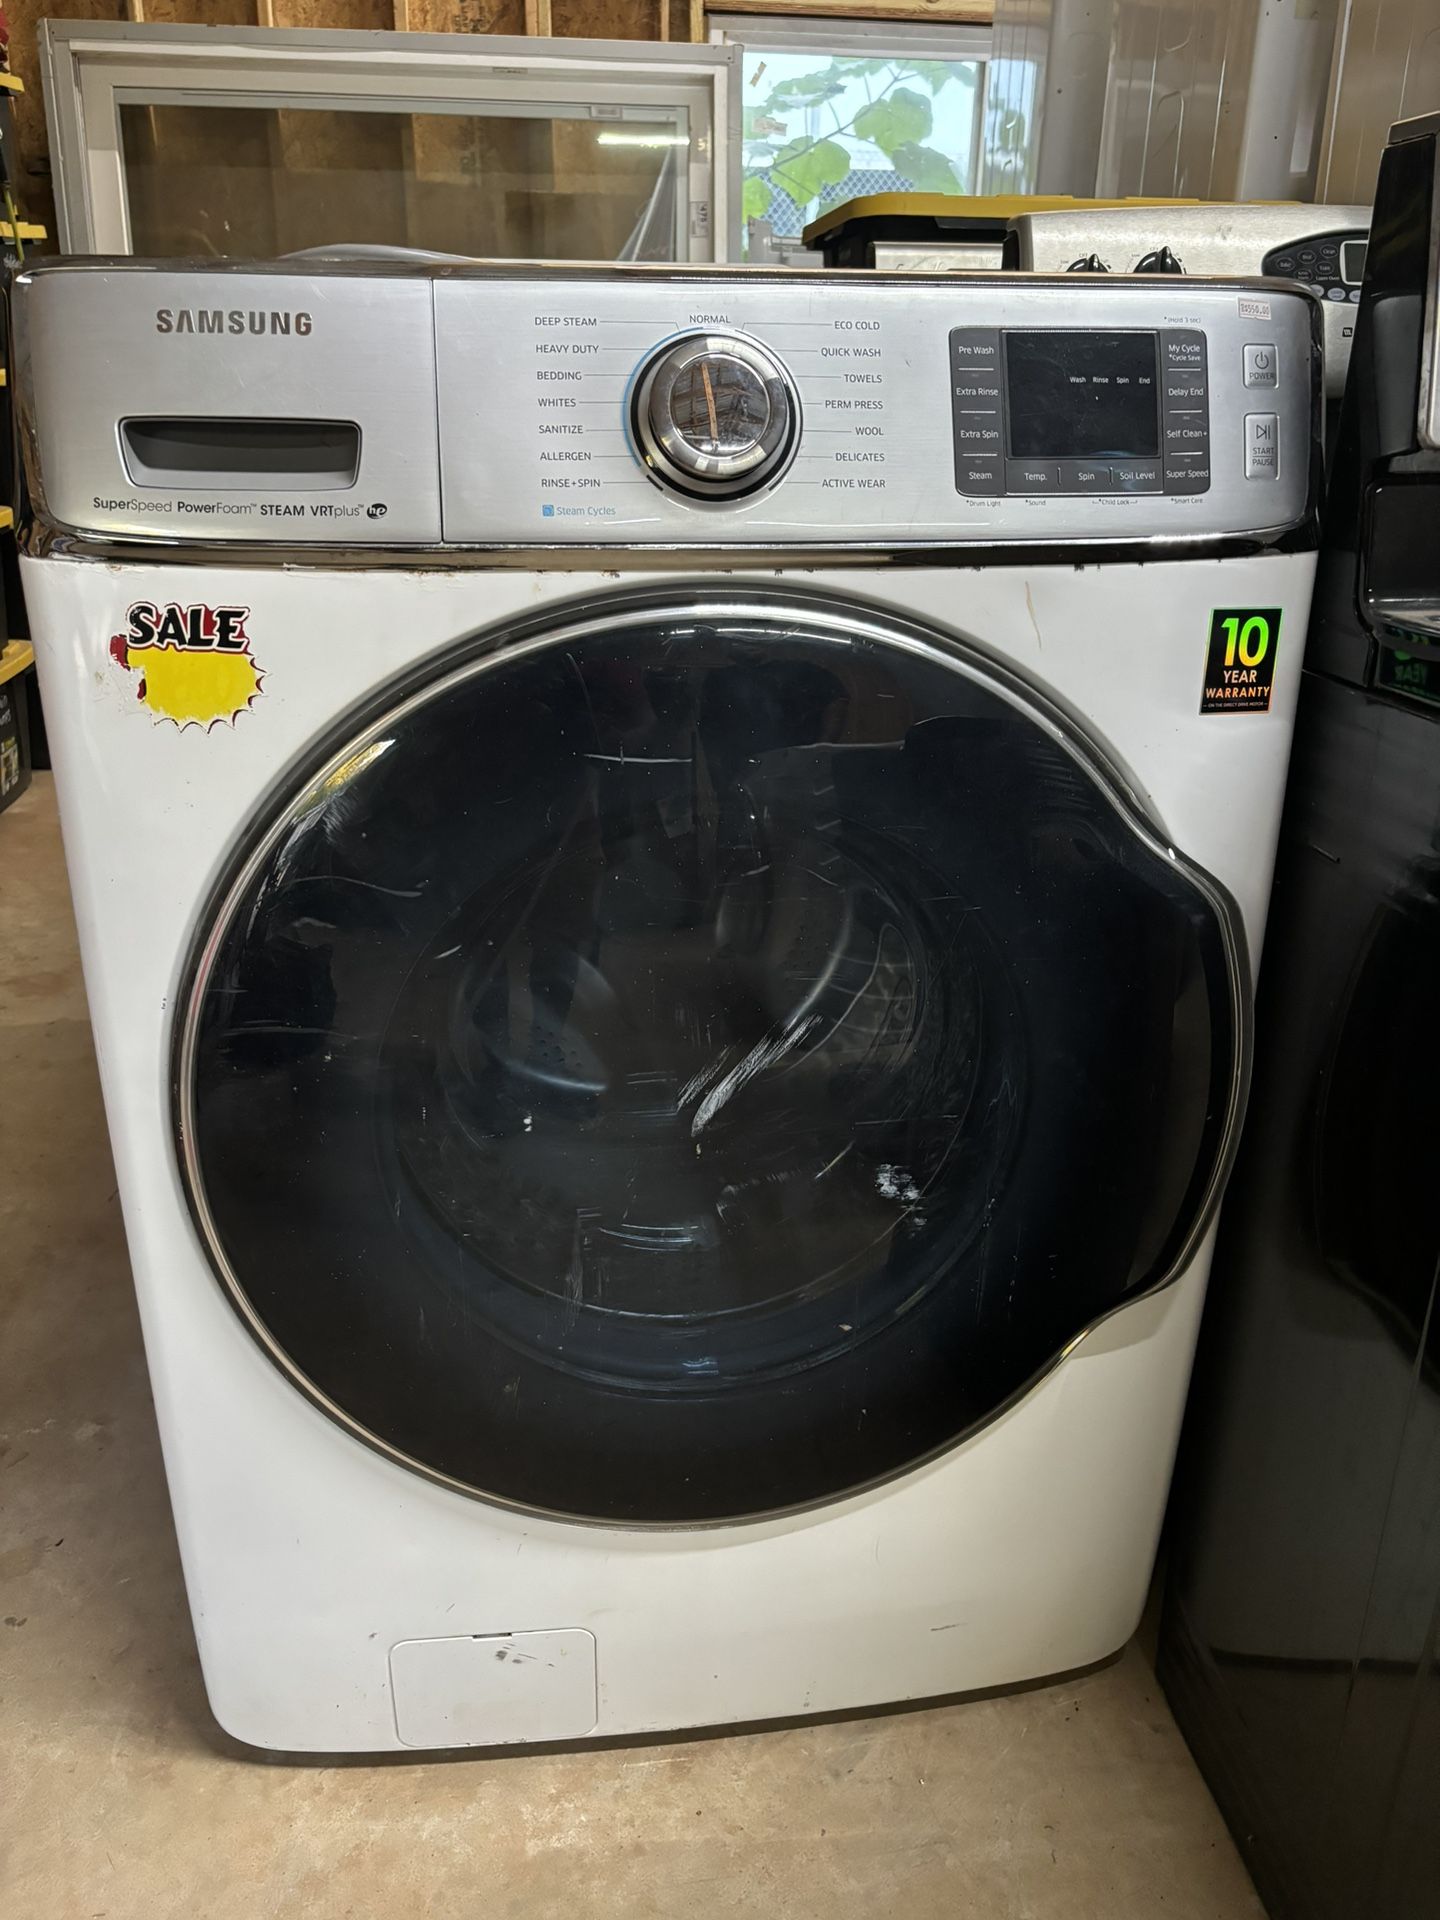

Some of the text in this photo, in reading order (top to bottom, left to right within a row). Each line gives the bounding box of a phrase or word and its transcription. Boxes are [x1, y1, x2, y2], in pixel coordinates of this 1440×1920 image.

[156, 309, 312, 336] SAMSUNG
[534, 317, 597, 327] DEEP STEAM
[689, 315, 731, 324] NORMAL
[834, 321, 880, 330] ECO COLD
[535, 345, 599, 354] HEAVY DUTY
[821, 347, 881, 357] QUICK WASH
[958, 346, 994, 354] Pre Wash
[1168, 344, 1200, 354] My Cycle
[536, 371, 582, 380] BEDDING
[843, 374, 883, 383] TOWELS
[1116, 376, 1130, 384] Spin
[1139, 376, 1151, 384] End
[1249, 372, 1275, 380] POWER
[956, 387, 999, 396] Extra Rinse
[1168, 386, 1204, 398] Delay End
[537, 398, 577, 407] WHITES
[825, 400, 884, 409] PERM PRESS
[538, 425, 584, 434] SANITIZE
[855, 426, 884, 436] WOOL
[1167, 429, 1181, 439] Self
[960, 430, 999, 440] Extra Spin
[1252, 447, 1275, 455] START
[539, 452, 591, 461] ALLERGEN
[835, 452, 885, 462] DELICATES
[1252, 458, 1275, 466] PAUSE
[968, 471, 993, 480] Steam
[1024, 472, 1048, 482] Temp.
[1078, 472, 1095, 481] Spin
[1120, 471, 1156, 480] Soil Level
[1166, 469, 1209, 479] Super Speed
[821, 478, 886, 488] ACTIVE WEAR
[93, 497, 172, 513] SuperSpeed
[260, 504, 305, 517] STEAM
[556, 505, 617, 517] Steam Cycles
[129, 605, 246, 650] SALE
[1221, 616, 1270, 667] 10
[1223, 670, 1258, 684] YEAR
[1205, 686, 1271, 698] WARRANTY
